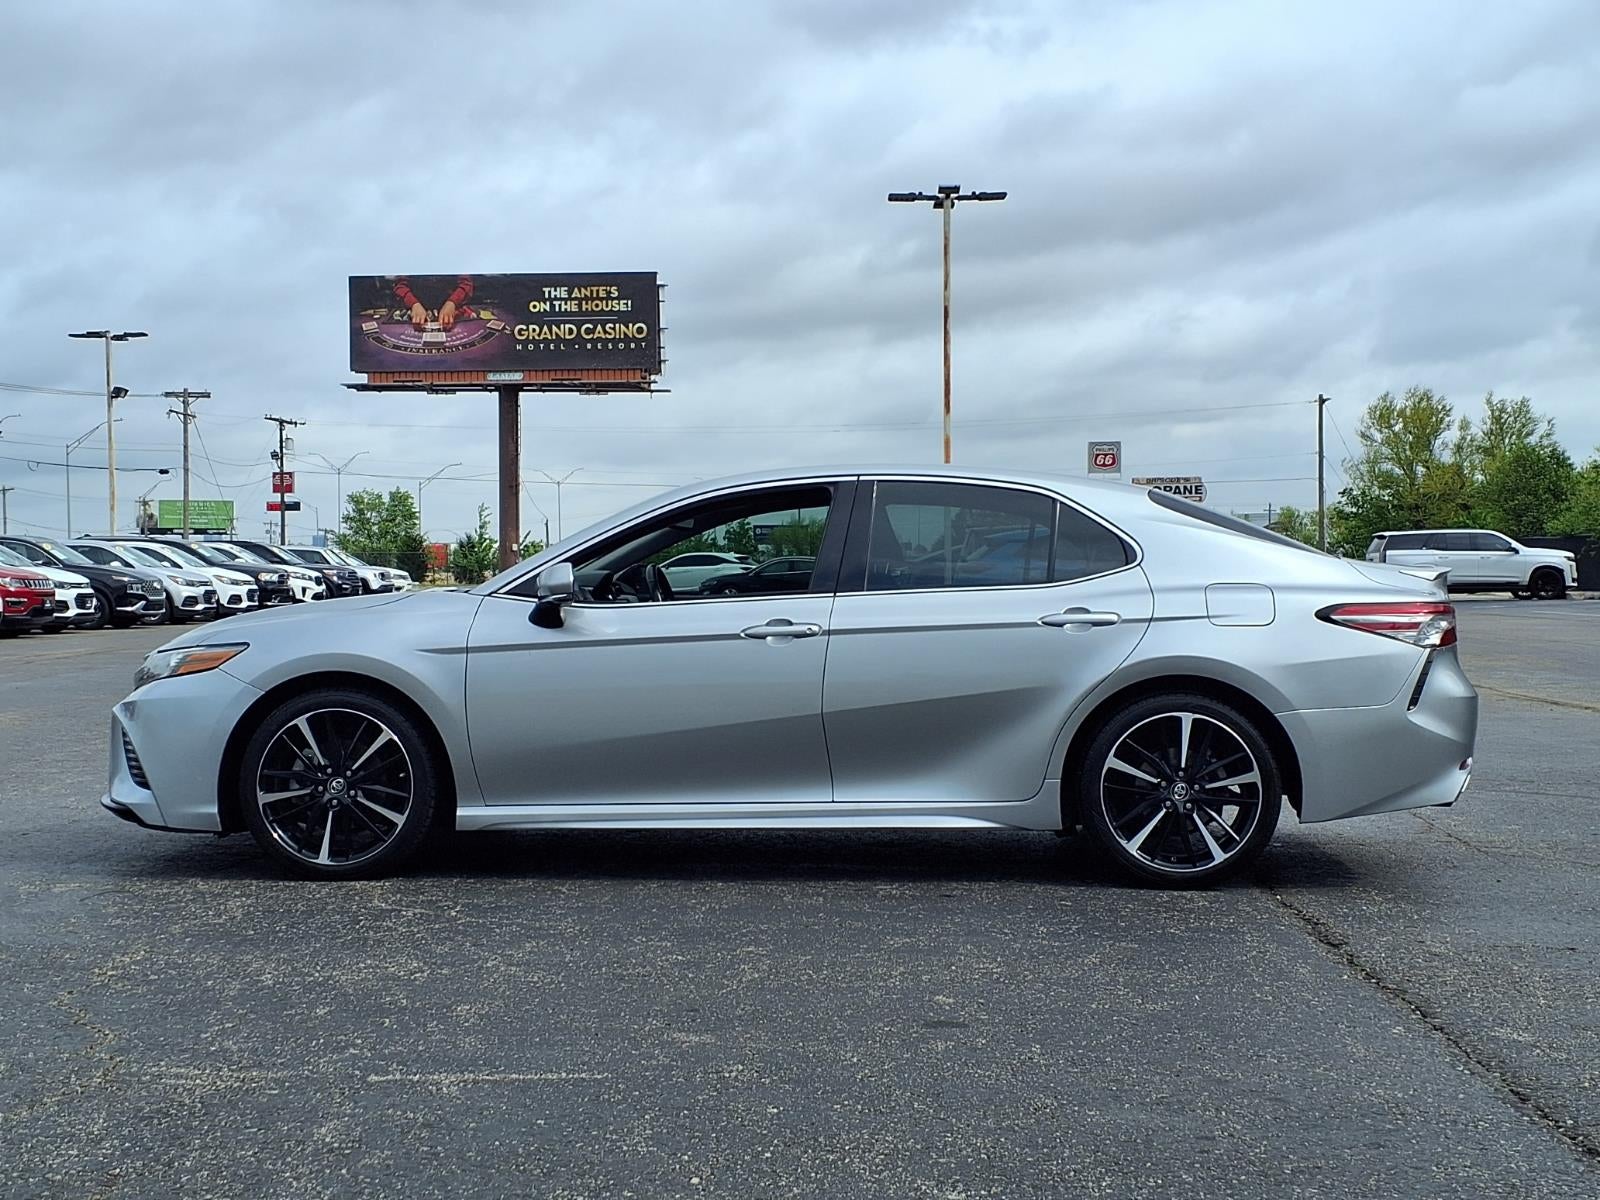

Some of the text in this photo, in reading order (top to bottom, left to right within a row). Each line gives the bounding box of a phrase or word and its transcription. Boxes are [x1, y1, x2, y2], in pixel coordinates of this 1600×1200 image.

[542, 286, 619, 298] THE ANTE'S
[529, 300, 632, 312] ON THE HOUSE!
[514, 323, 648, 340] GRAND CASINO
[516, 342, 647, 351] HOTEL RESORT
[1096, 454, 1113, 465] 66
